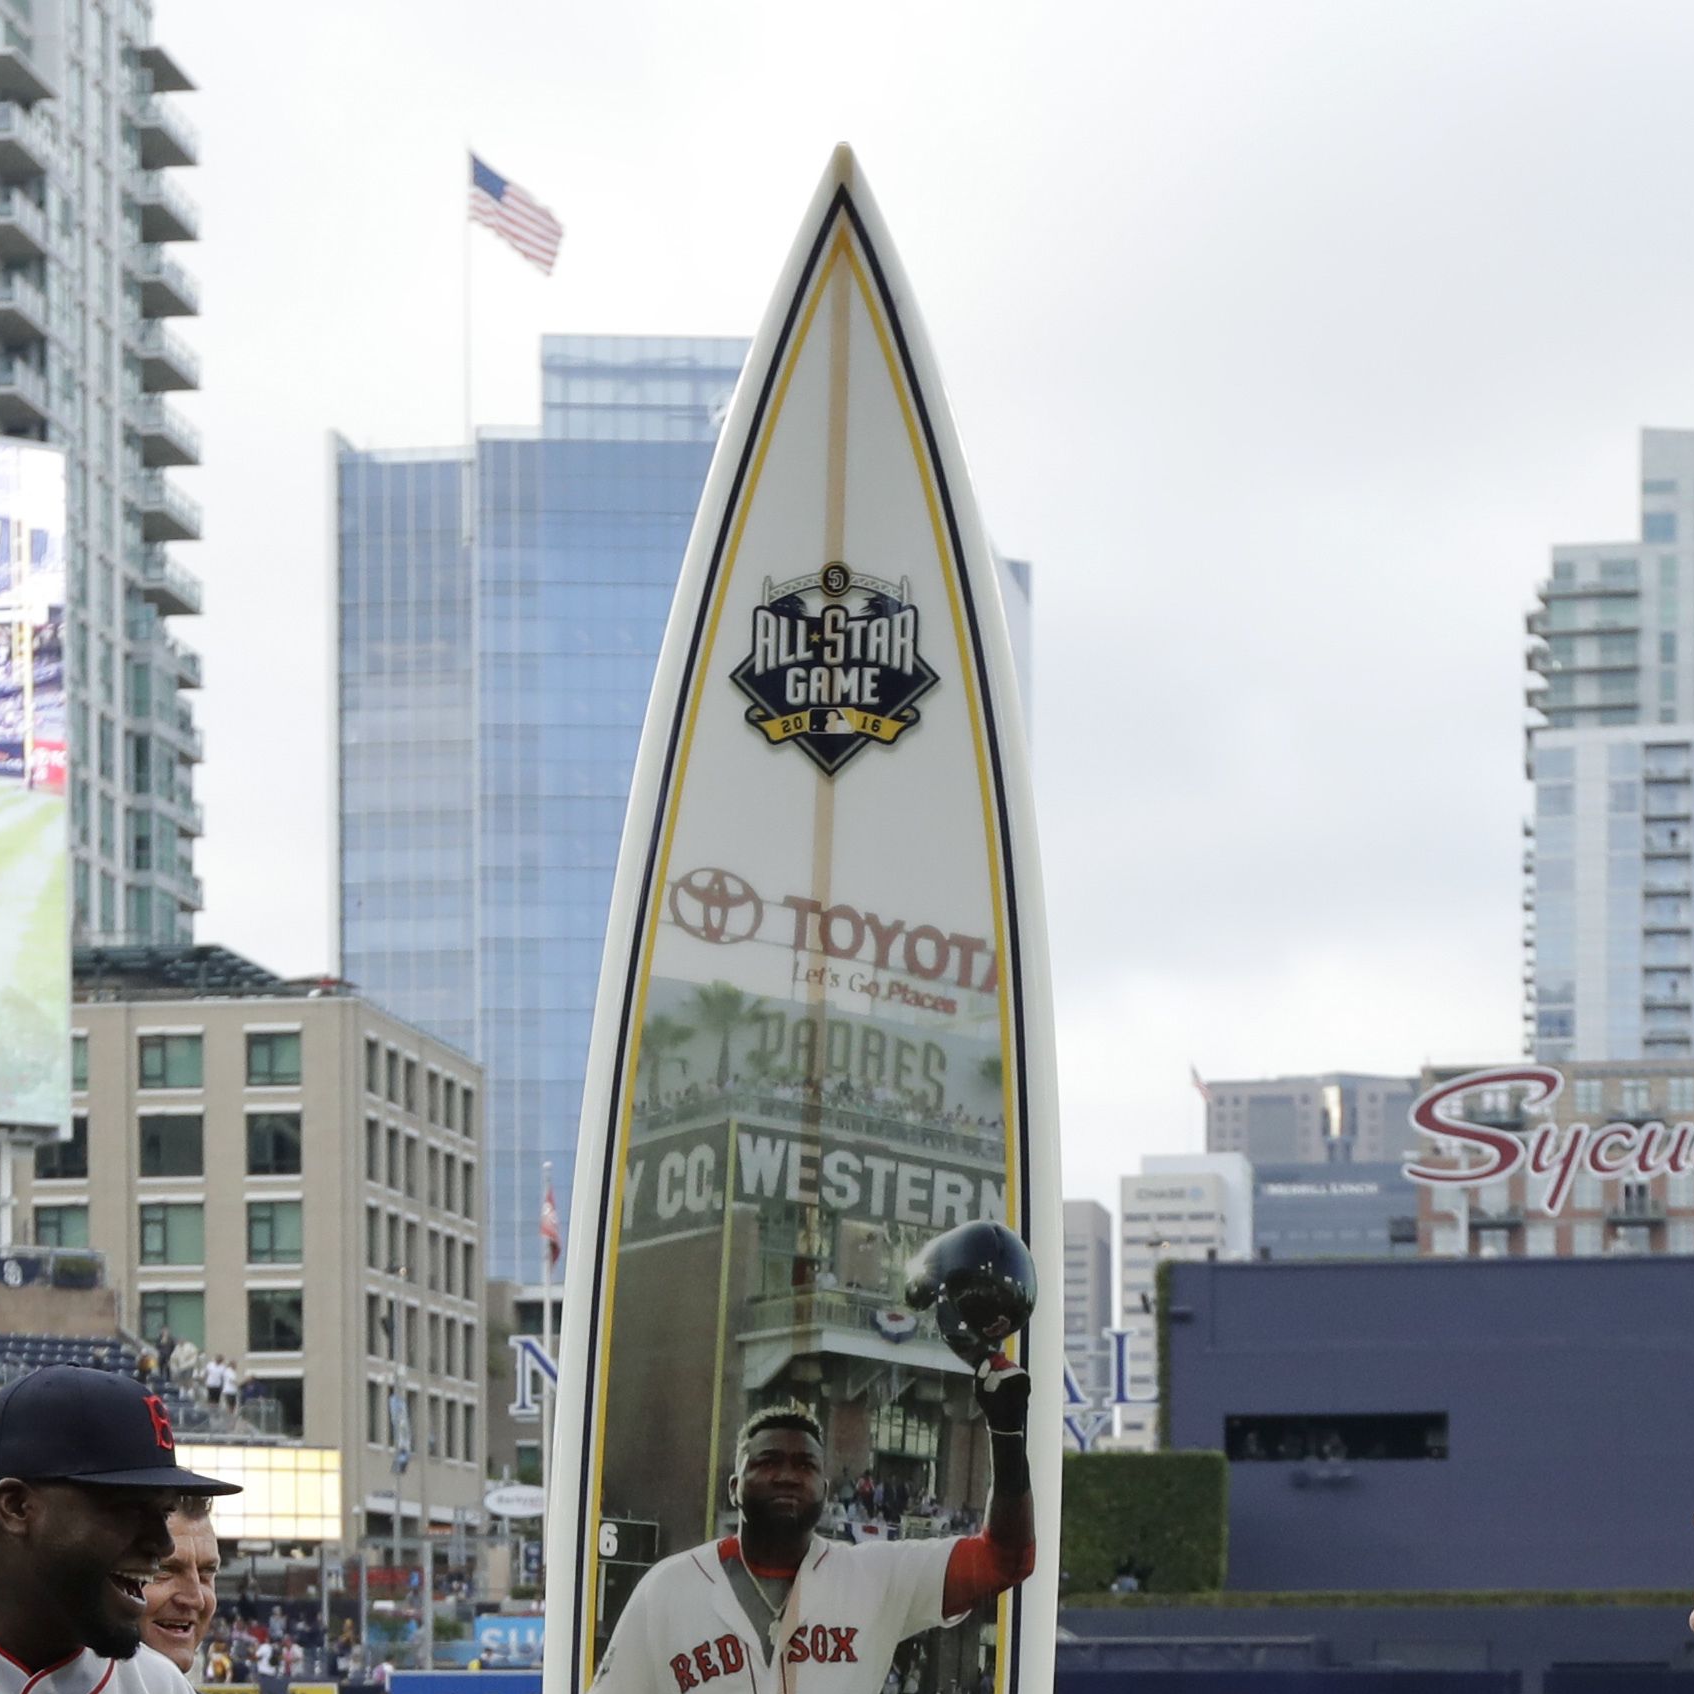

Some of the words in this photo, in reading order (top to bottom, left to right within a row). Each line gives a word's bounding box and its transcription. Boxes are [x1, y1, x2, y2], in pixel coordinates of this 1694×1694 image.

[755, 606, 814, 677] ALL
[822, 604, 916, 677] STAR
[785, 666, 882, 706] GAME
[792, 961, 840, 988] Let's
[848, 972, 881, 999] Go
[887, 981, 958, 1015] Places
[756, 1009, 947, 1112] PADRES
[656, 1144, 724, 1220] CO.
[598, 1522, 618, 1557] 6
[787, 1623, 859, 1664] SOX
